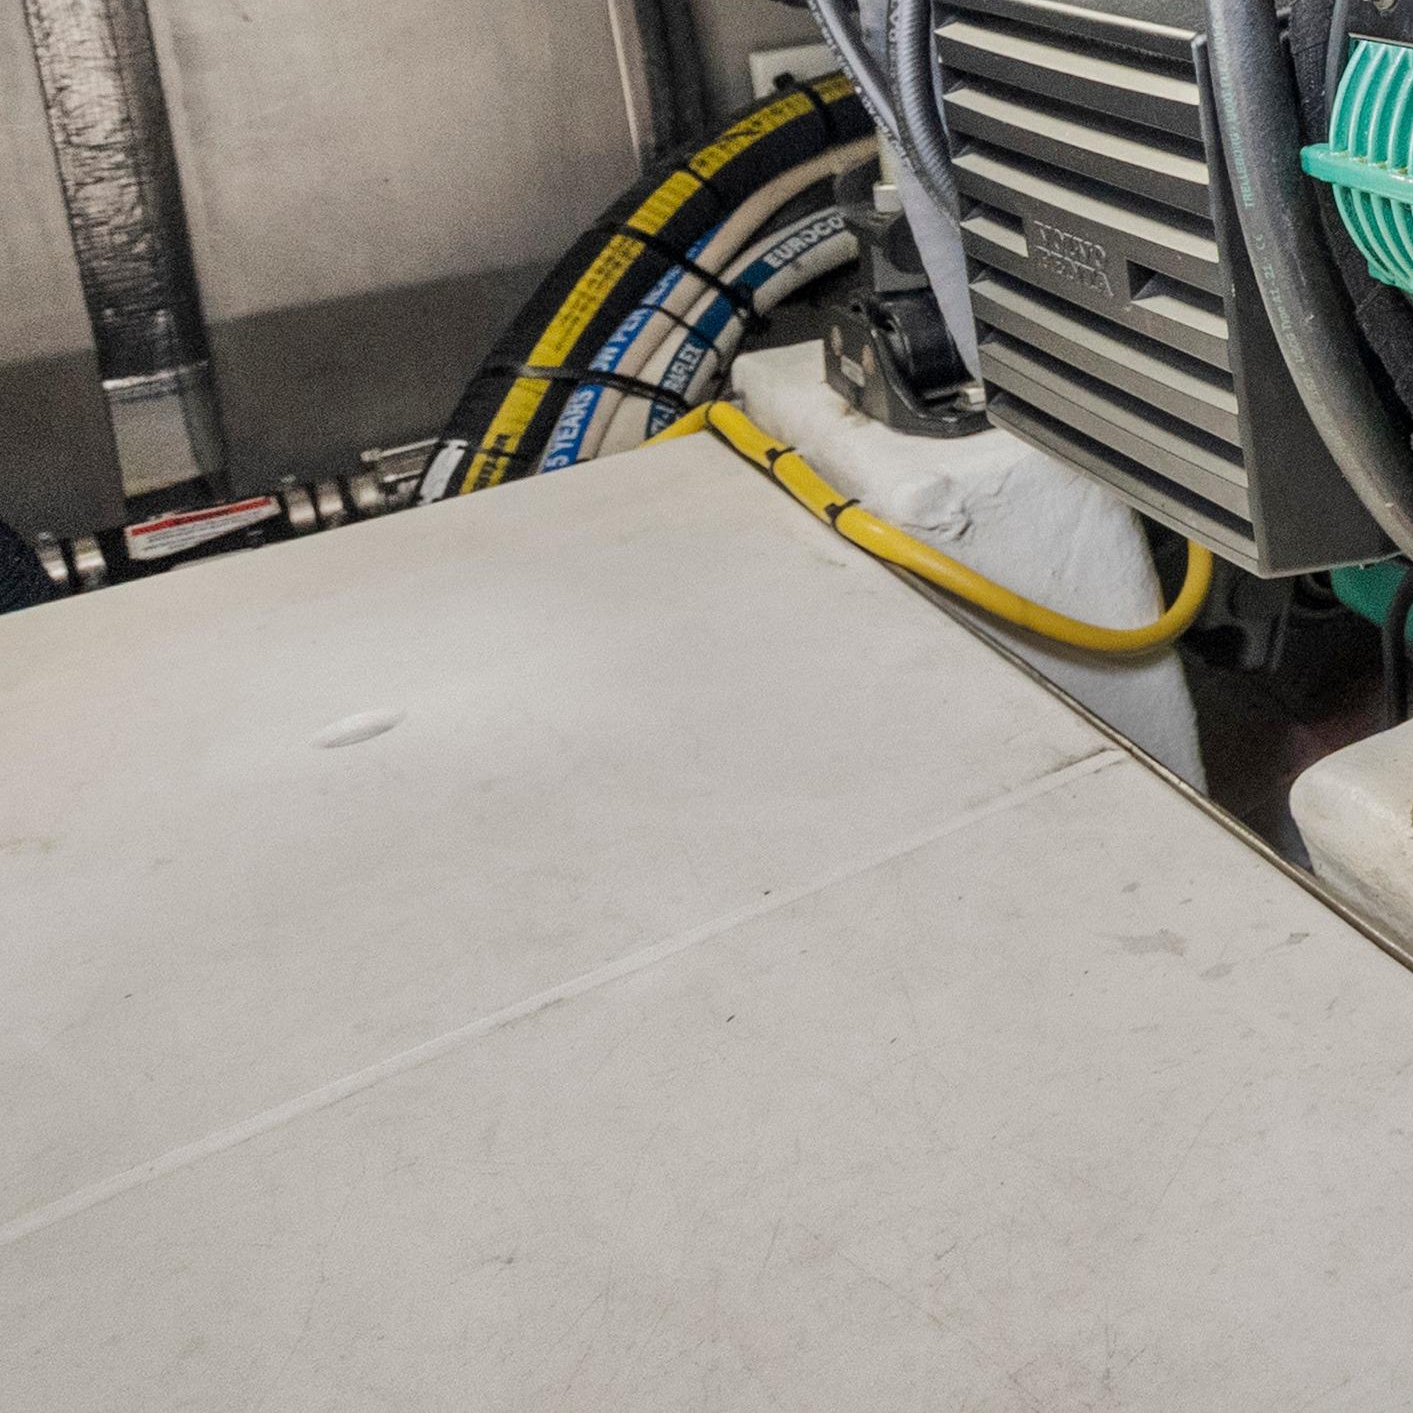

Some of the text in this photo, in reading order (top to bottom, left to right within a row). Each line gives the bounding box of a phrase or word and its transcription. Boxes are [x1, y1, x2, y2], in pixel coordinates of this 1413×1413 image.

[1229, 131, 1254, 209] TRELLEBORG
[1033, 220, 1106, 267] VOLVO
[1035, 245, 1114, 297] PENTA
